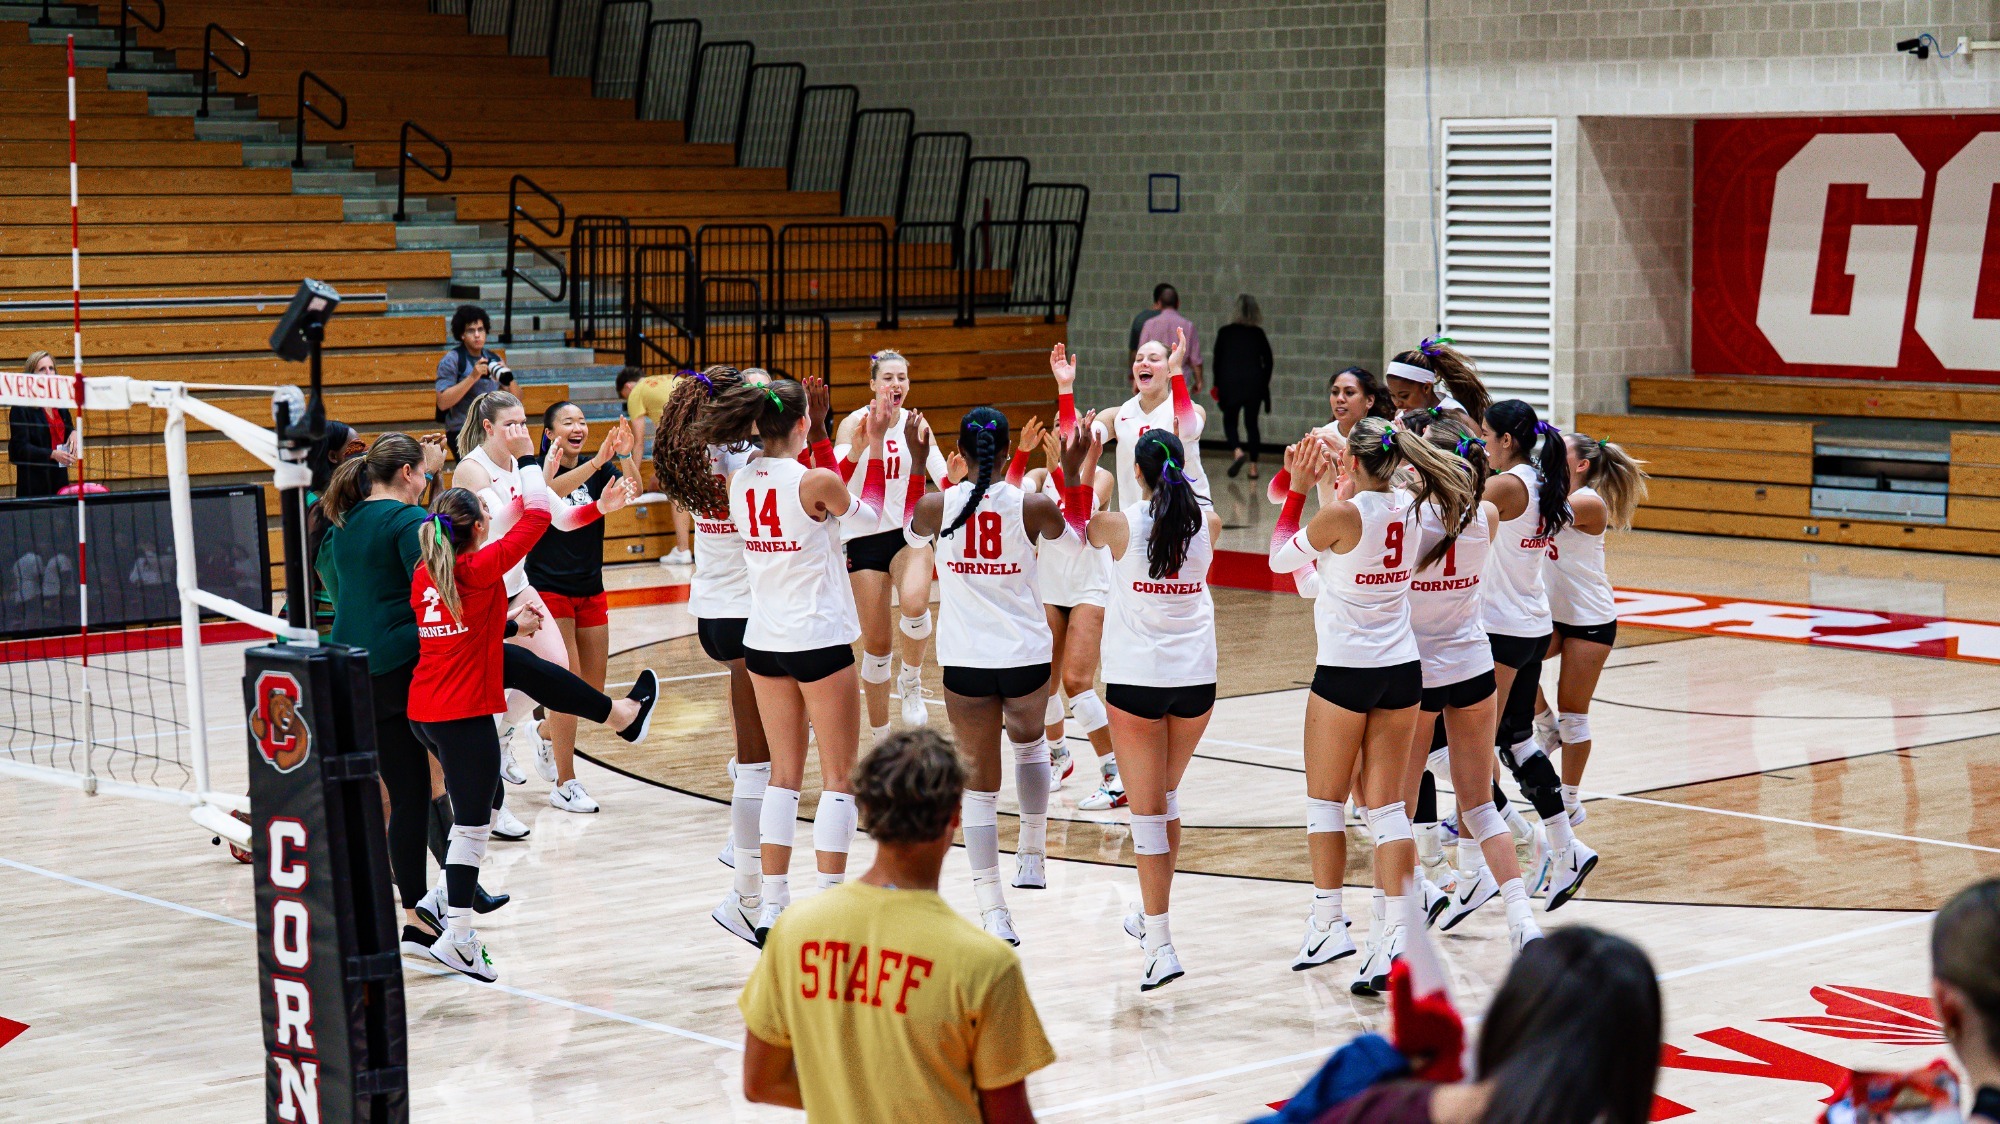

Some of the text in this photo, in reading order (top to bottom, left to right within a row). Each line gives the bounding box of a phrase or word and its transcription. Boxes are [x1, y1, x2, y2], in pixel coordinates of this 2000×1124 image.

[0, 375, 75, 400] VERSITY
[886, 456, 900, 479] 11
[746, 488, 782, 537] 14
[964, 511, 1002, 559] 18
[1383, 521, 1403, 568] 9
[947, 561, 1021, 575] CORNELL
[1411, 574, 1479, 592] CORNELL
[1132, 581, 1202, 595] CORNELL
[421, 586, 441, 623] 2
[801, 941, 934, 1014] STAFF
